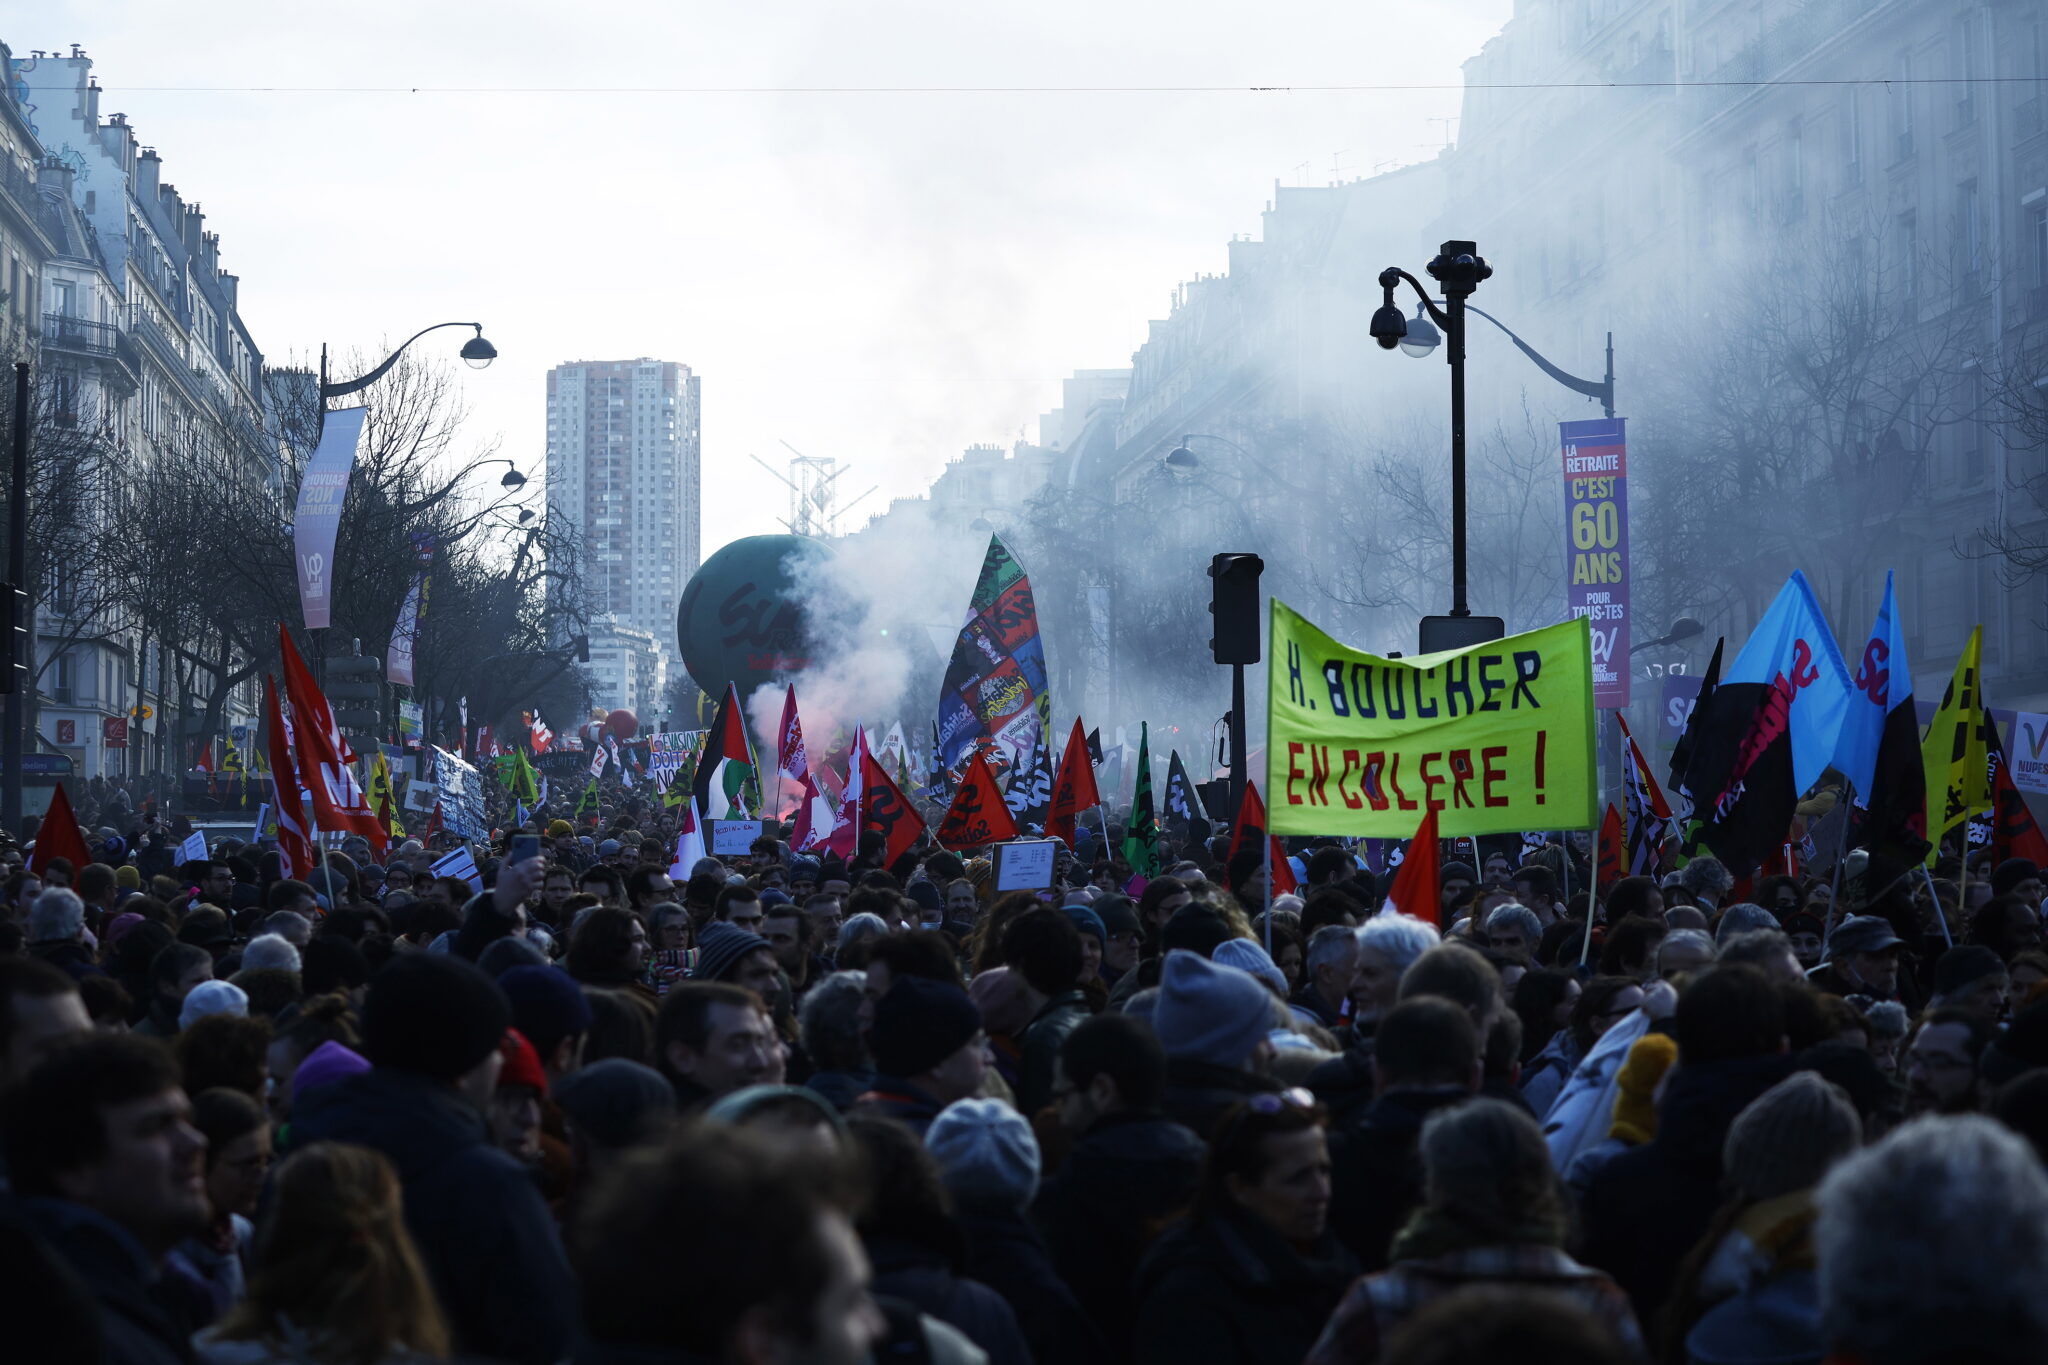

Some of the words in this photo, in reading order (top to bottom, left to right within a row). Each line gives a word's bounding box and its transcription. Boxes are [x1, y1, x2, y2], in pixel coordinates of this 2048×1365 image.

[1565, 444, 1577, 457] LA
[1566, 455, 1619, 473] RETRAITE
[1572, 476, 1616, 500] C'EST
[1571, 501, 1619, 550] 60
[1572, 552, 1622, 586] ANS
[1586, 592, 1611, 605] POUR
[1322, 650, 1542, 720] BOUCHER
[1287, 742, 1329, 807] EN
[1338, 745, 1509, 812] COLERE
[1535, 730, 1547, 805] !
[2018, 759, 2048, 775] NUPES
